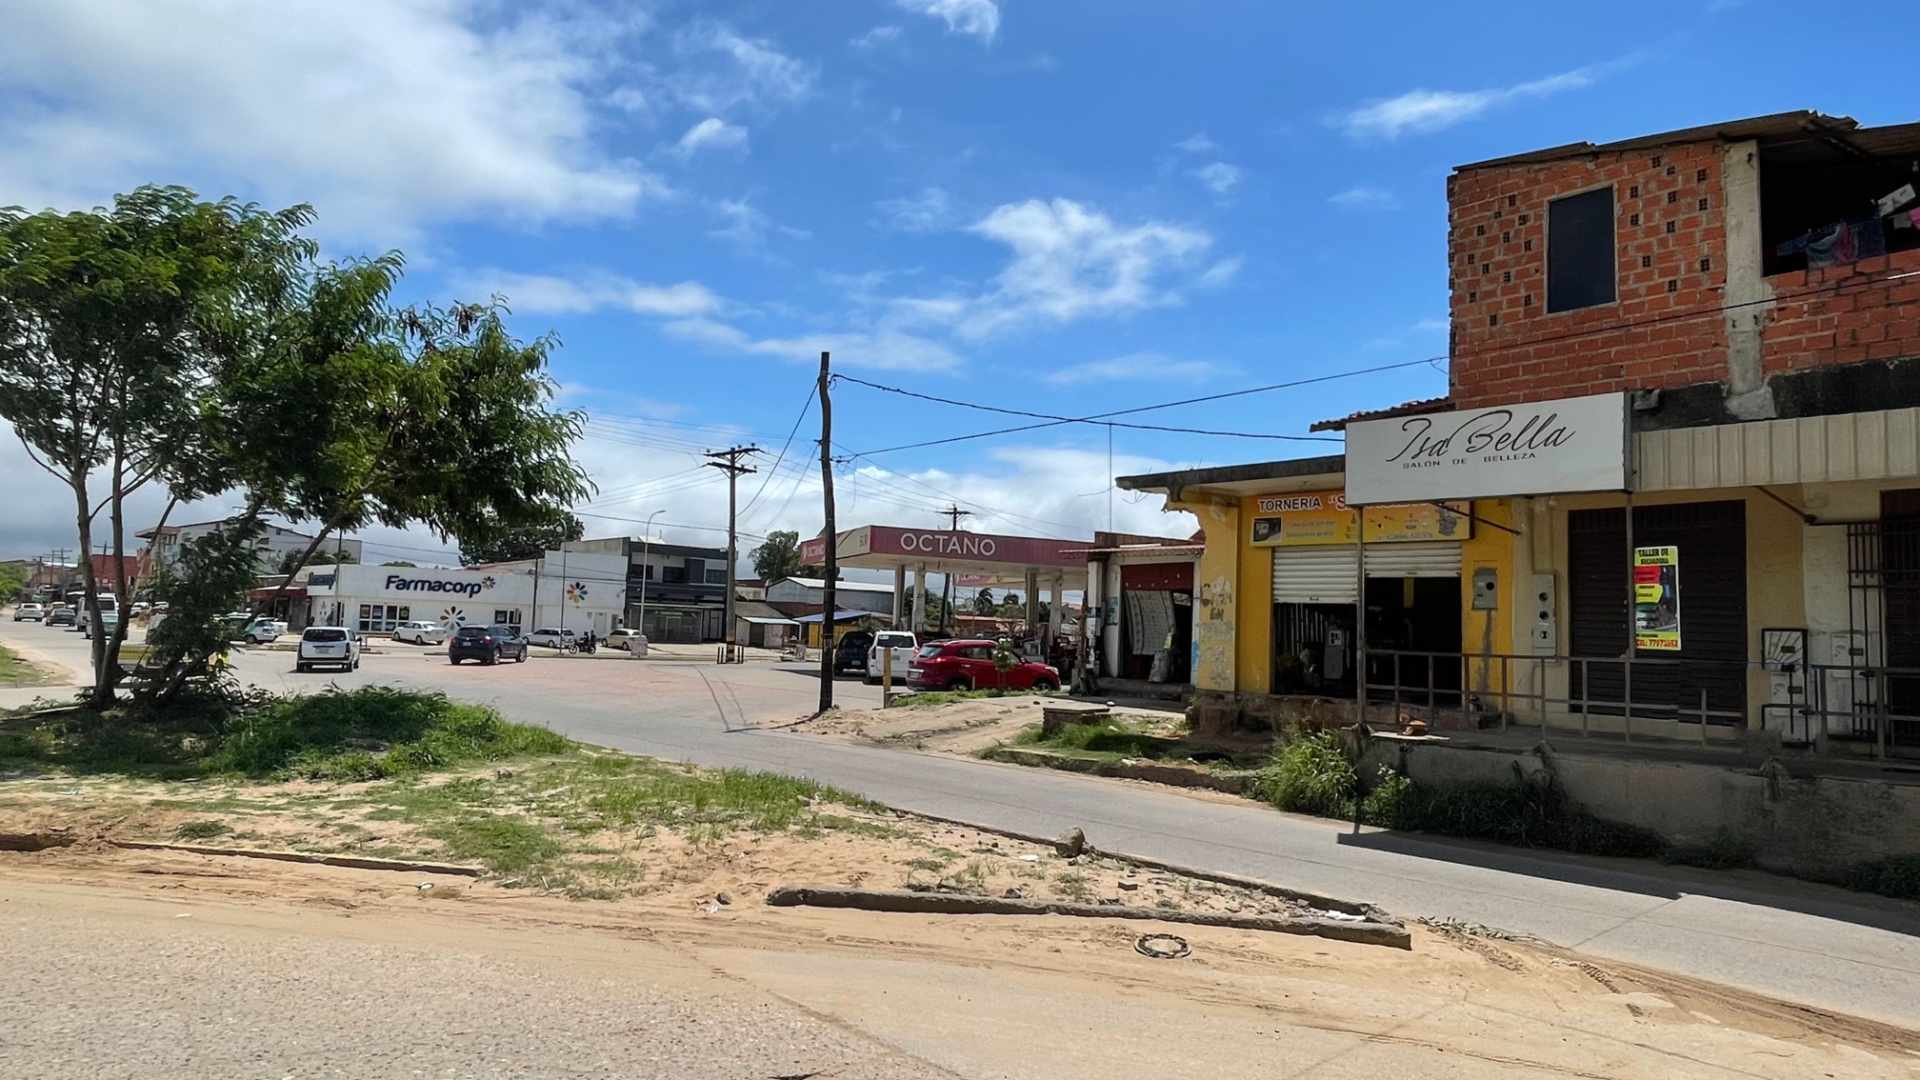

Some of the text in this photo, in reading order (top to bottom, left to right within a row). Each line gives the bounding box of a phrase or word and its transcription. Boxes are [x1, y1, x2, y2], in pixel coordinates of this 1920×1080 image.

[1385, 411, 1576, 462] Isa Bella
[1451, 457, 1468, 466] DE
[1483, 452, 1537, 464] BELLEZA
[1258, 495, 1322, 512] TORNERIA
[900, 532, 996, 556] OCTANO
[385, 575, 482, 598] Farmacorp
